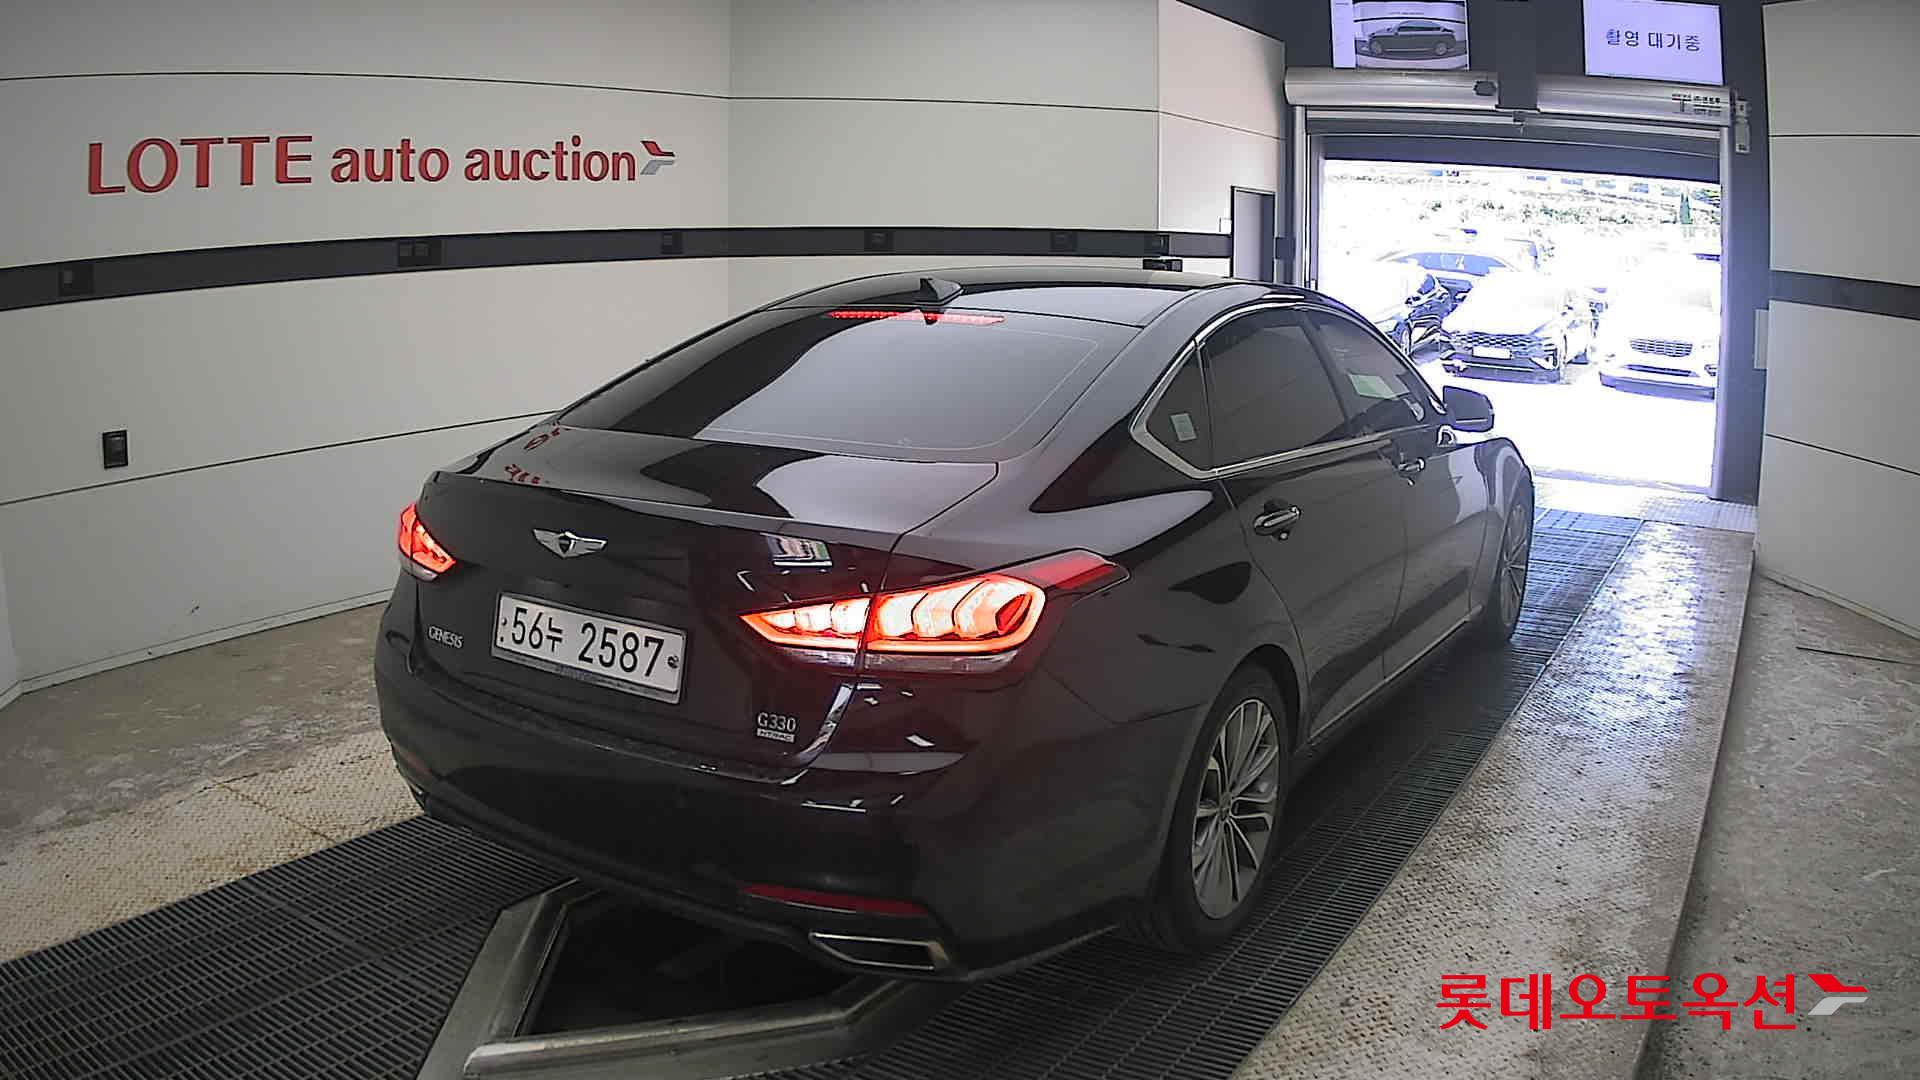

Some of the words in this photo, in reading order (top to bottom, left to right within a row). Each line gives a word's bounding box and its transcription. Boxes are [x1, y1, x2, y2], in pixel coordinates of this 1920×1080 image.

[1606, 28, 1640, 47] 촬영
[1647, 31, 1701, 52] 대기중
[88, 135, 314, 195] LOTTE
[330, 138, 451, 183] auto
[464, 135, 637, 182] auction
[429, 626, 464, 648] GENESIS
[511, 606, 564, 652] 56누
[578, 622, 665, 678] 2587
[757, 711, 797, 732] G330
